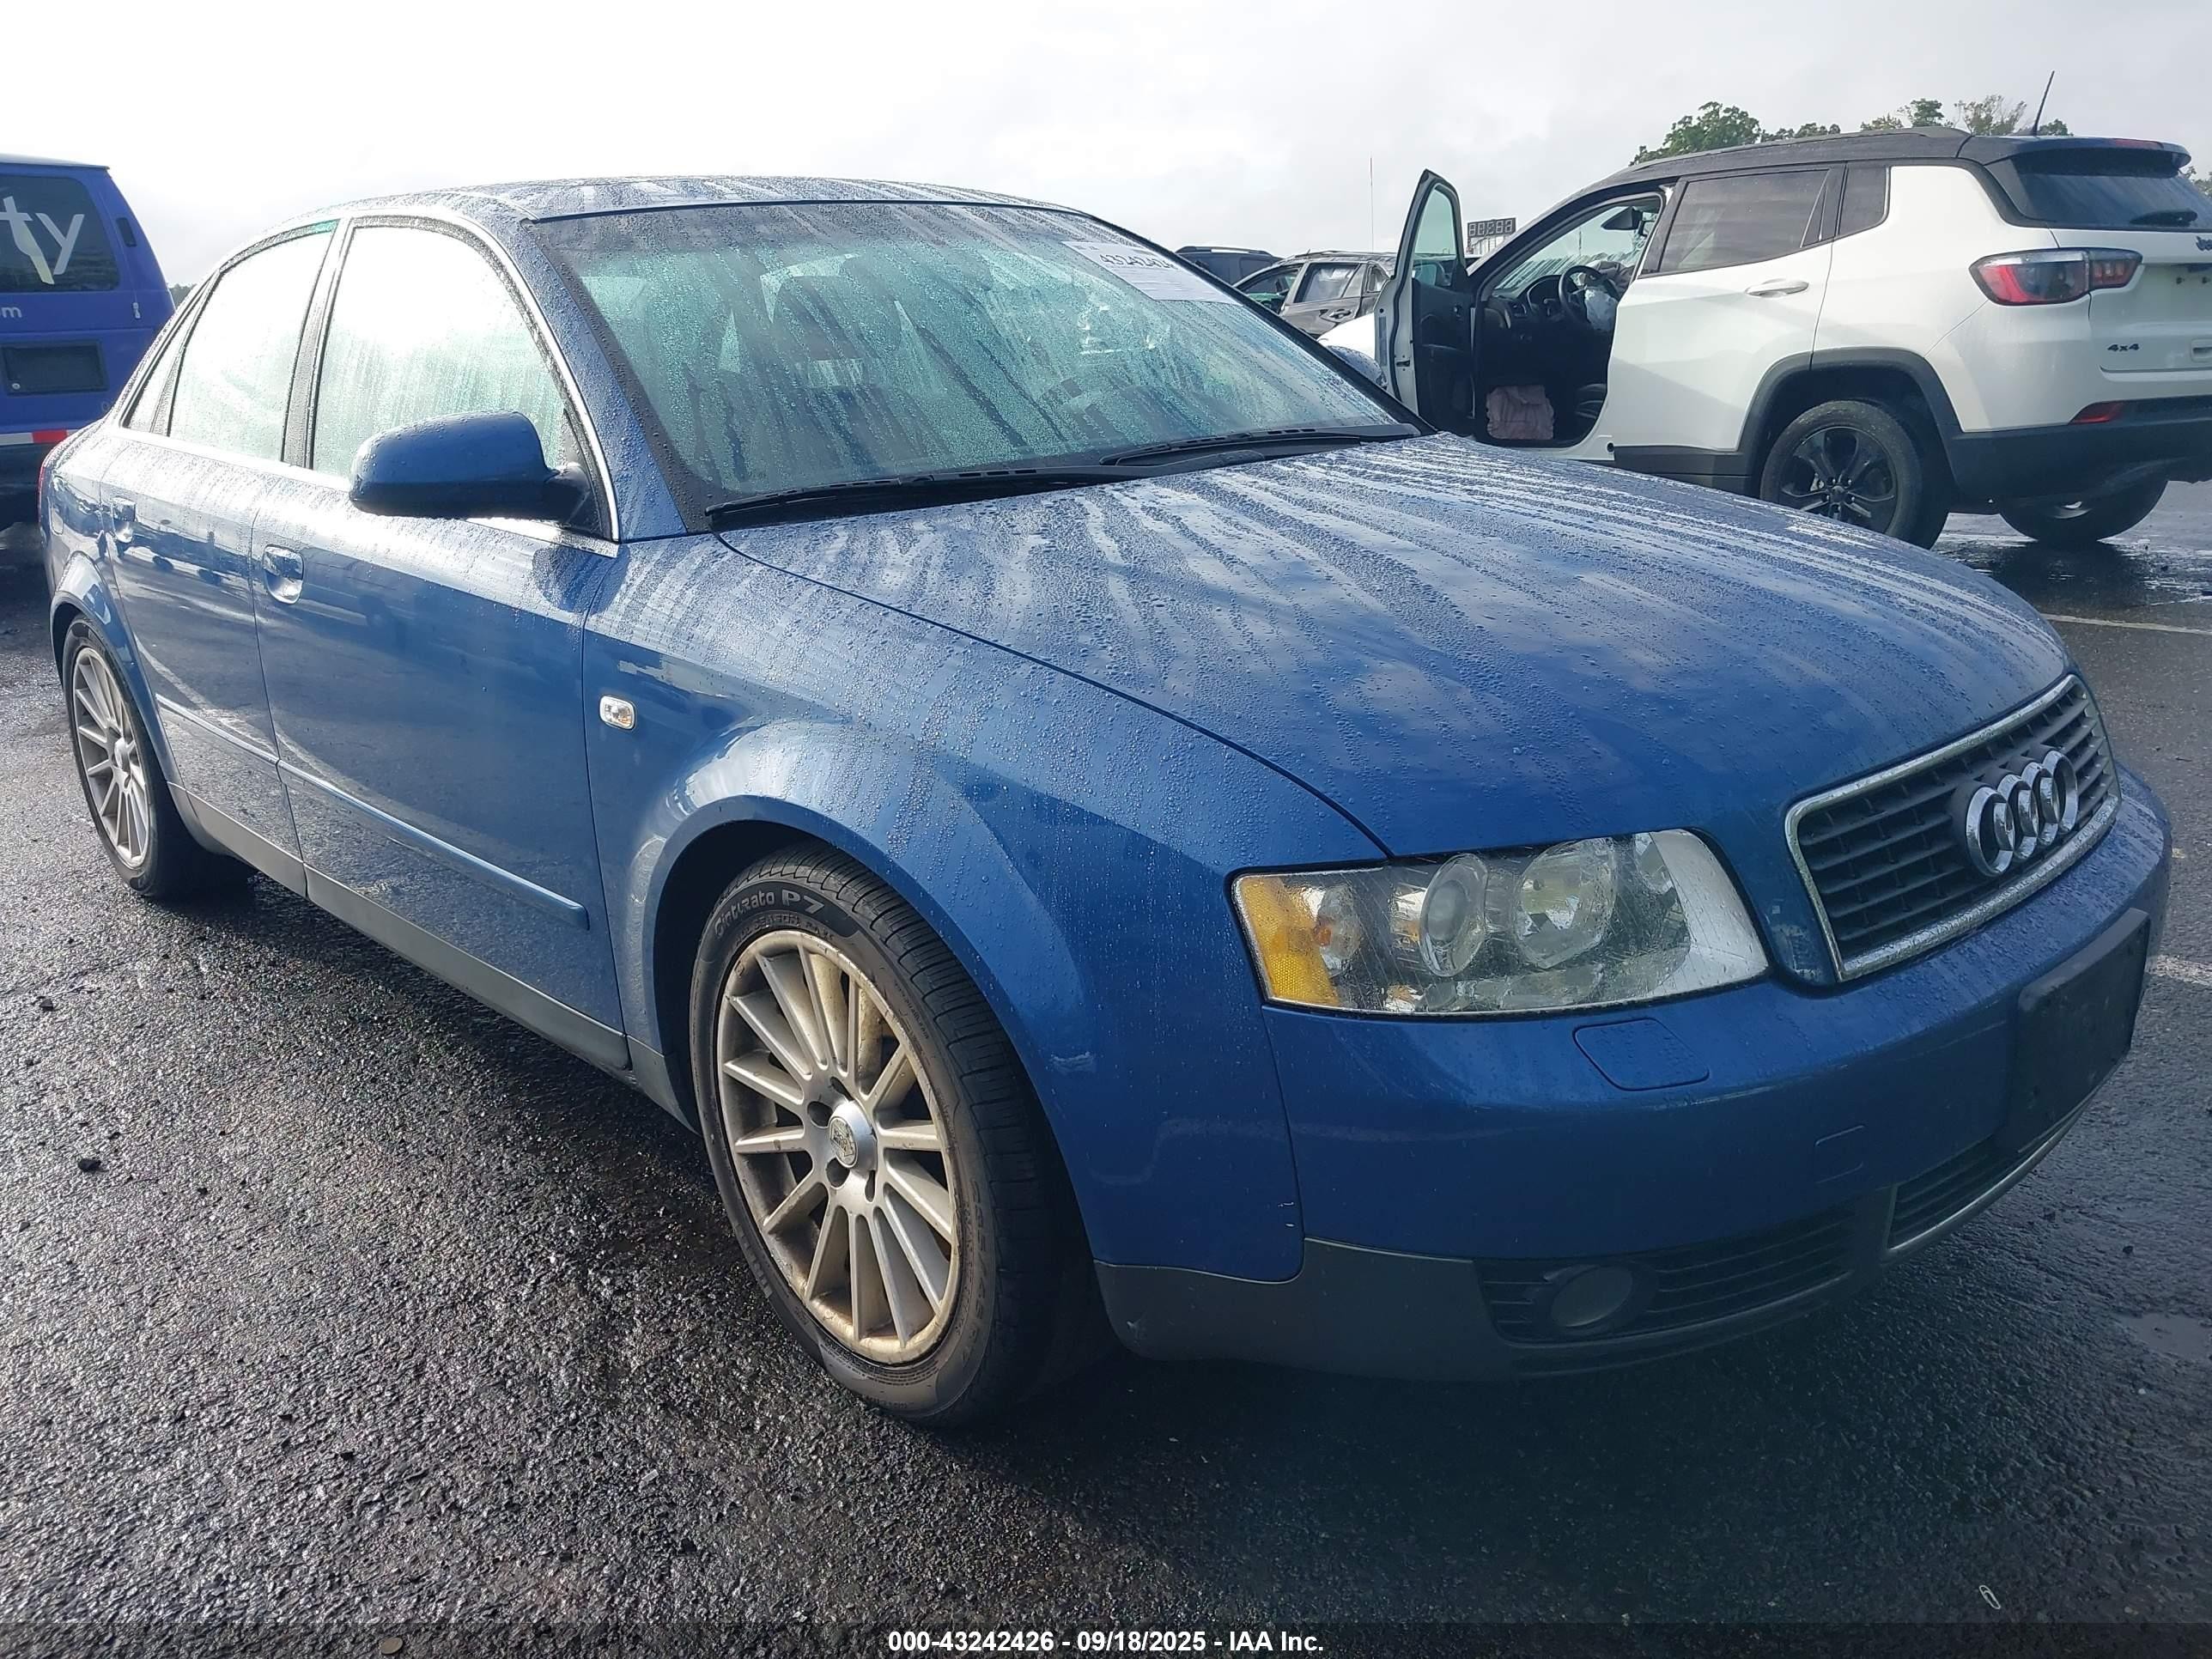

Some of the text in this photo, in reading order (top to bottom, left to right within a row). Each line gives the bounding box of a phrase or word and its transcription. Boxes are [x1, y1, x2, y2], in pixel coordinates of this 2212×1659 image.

[2107, 343, 2140, 352] 4x4
[714, 889, 825, 939] Cinturato P7
